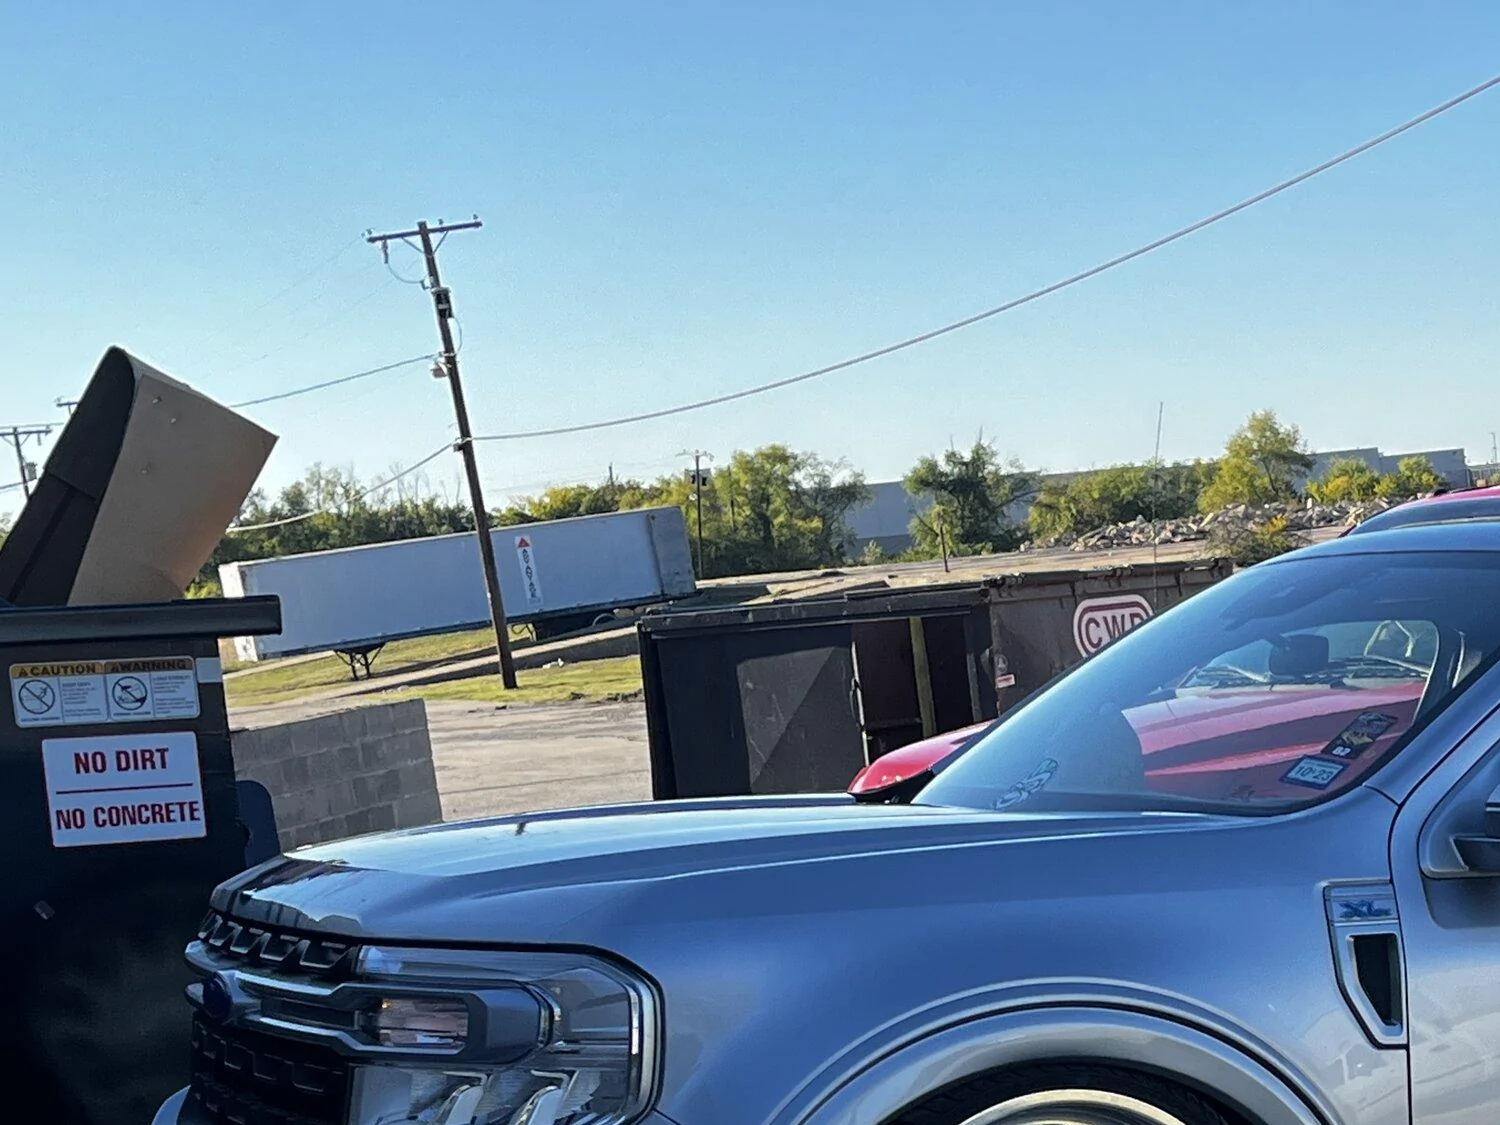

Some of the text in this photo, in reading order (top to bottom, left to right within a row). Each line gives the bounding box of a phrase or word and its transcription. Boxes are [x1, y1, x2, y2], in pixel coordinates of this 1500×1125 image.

[28, 663, 96, 677] CAUTION
[118, 658, 187, 673] WARNING
[73, 747, 169, 774] NO DIRT
[56, 800, 201, 830] NO CONCRETE
